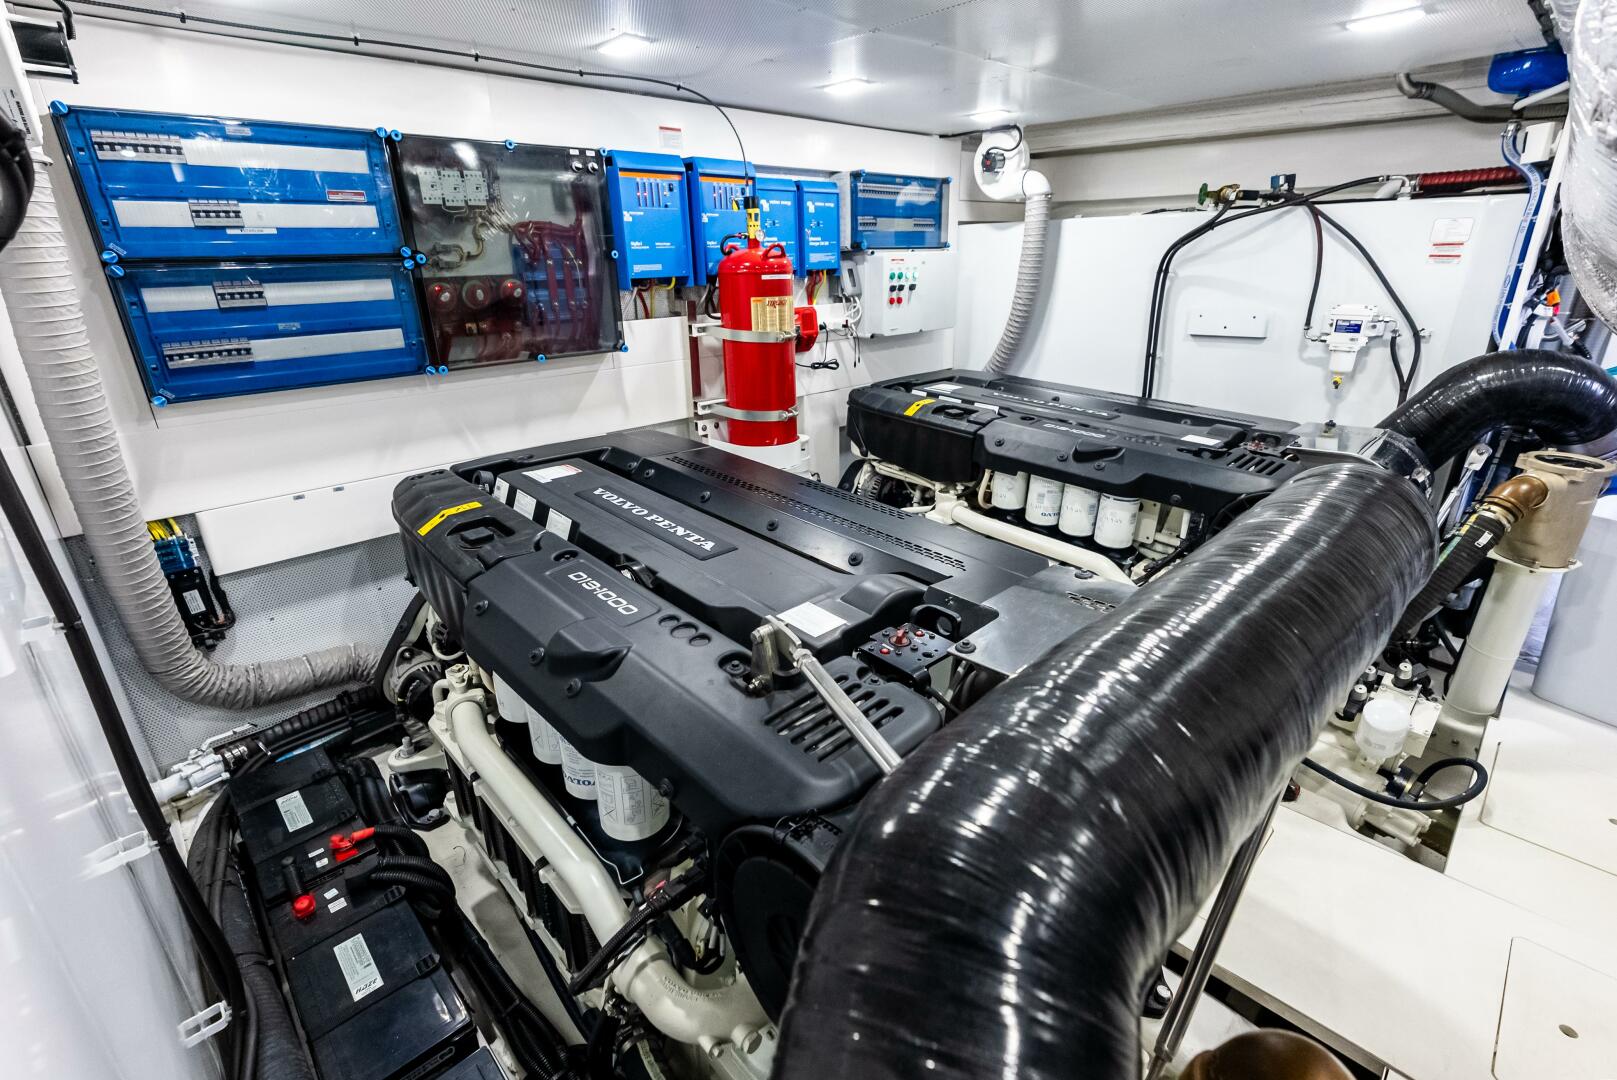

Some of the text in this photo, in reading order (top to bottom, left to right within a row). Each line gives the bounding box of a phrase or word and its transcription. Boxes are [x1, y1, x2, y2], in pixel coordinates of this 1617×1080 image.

[592, 487, 716, 552] VOLVO PENTA
[567, 571, 639, 615] D13-1000
